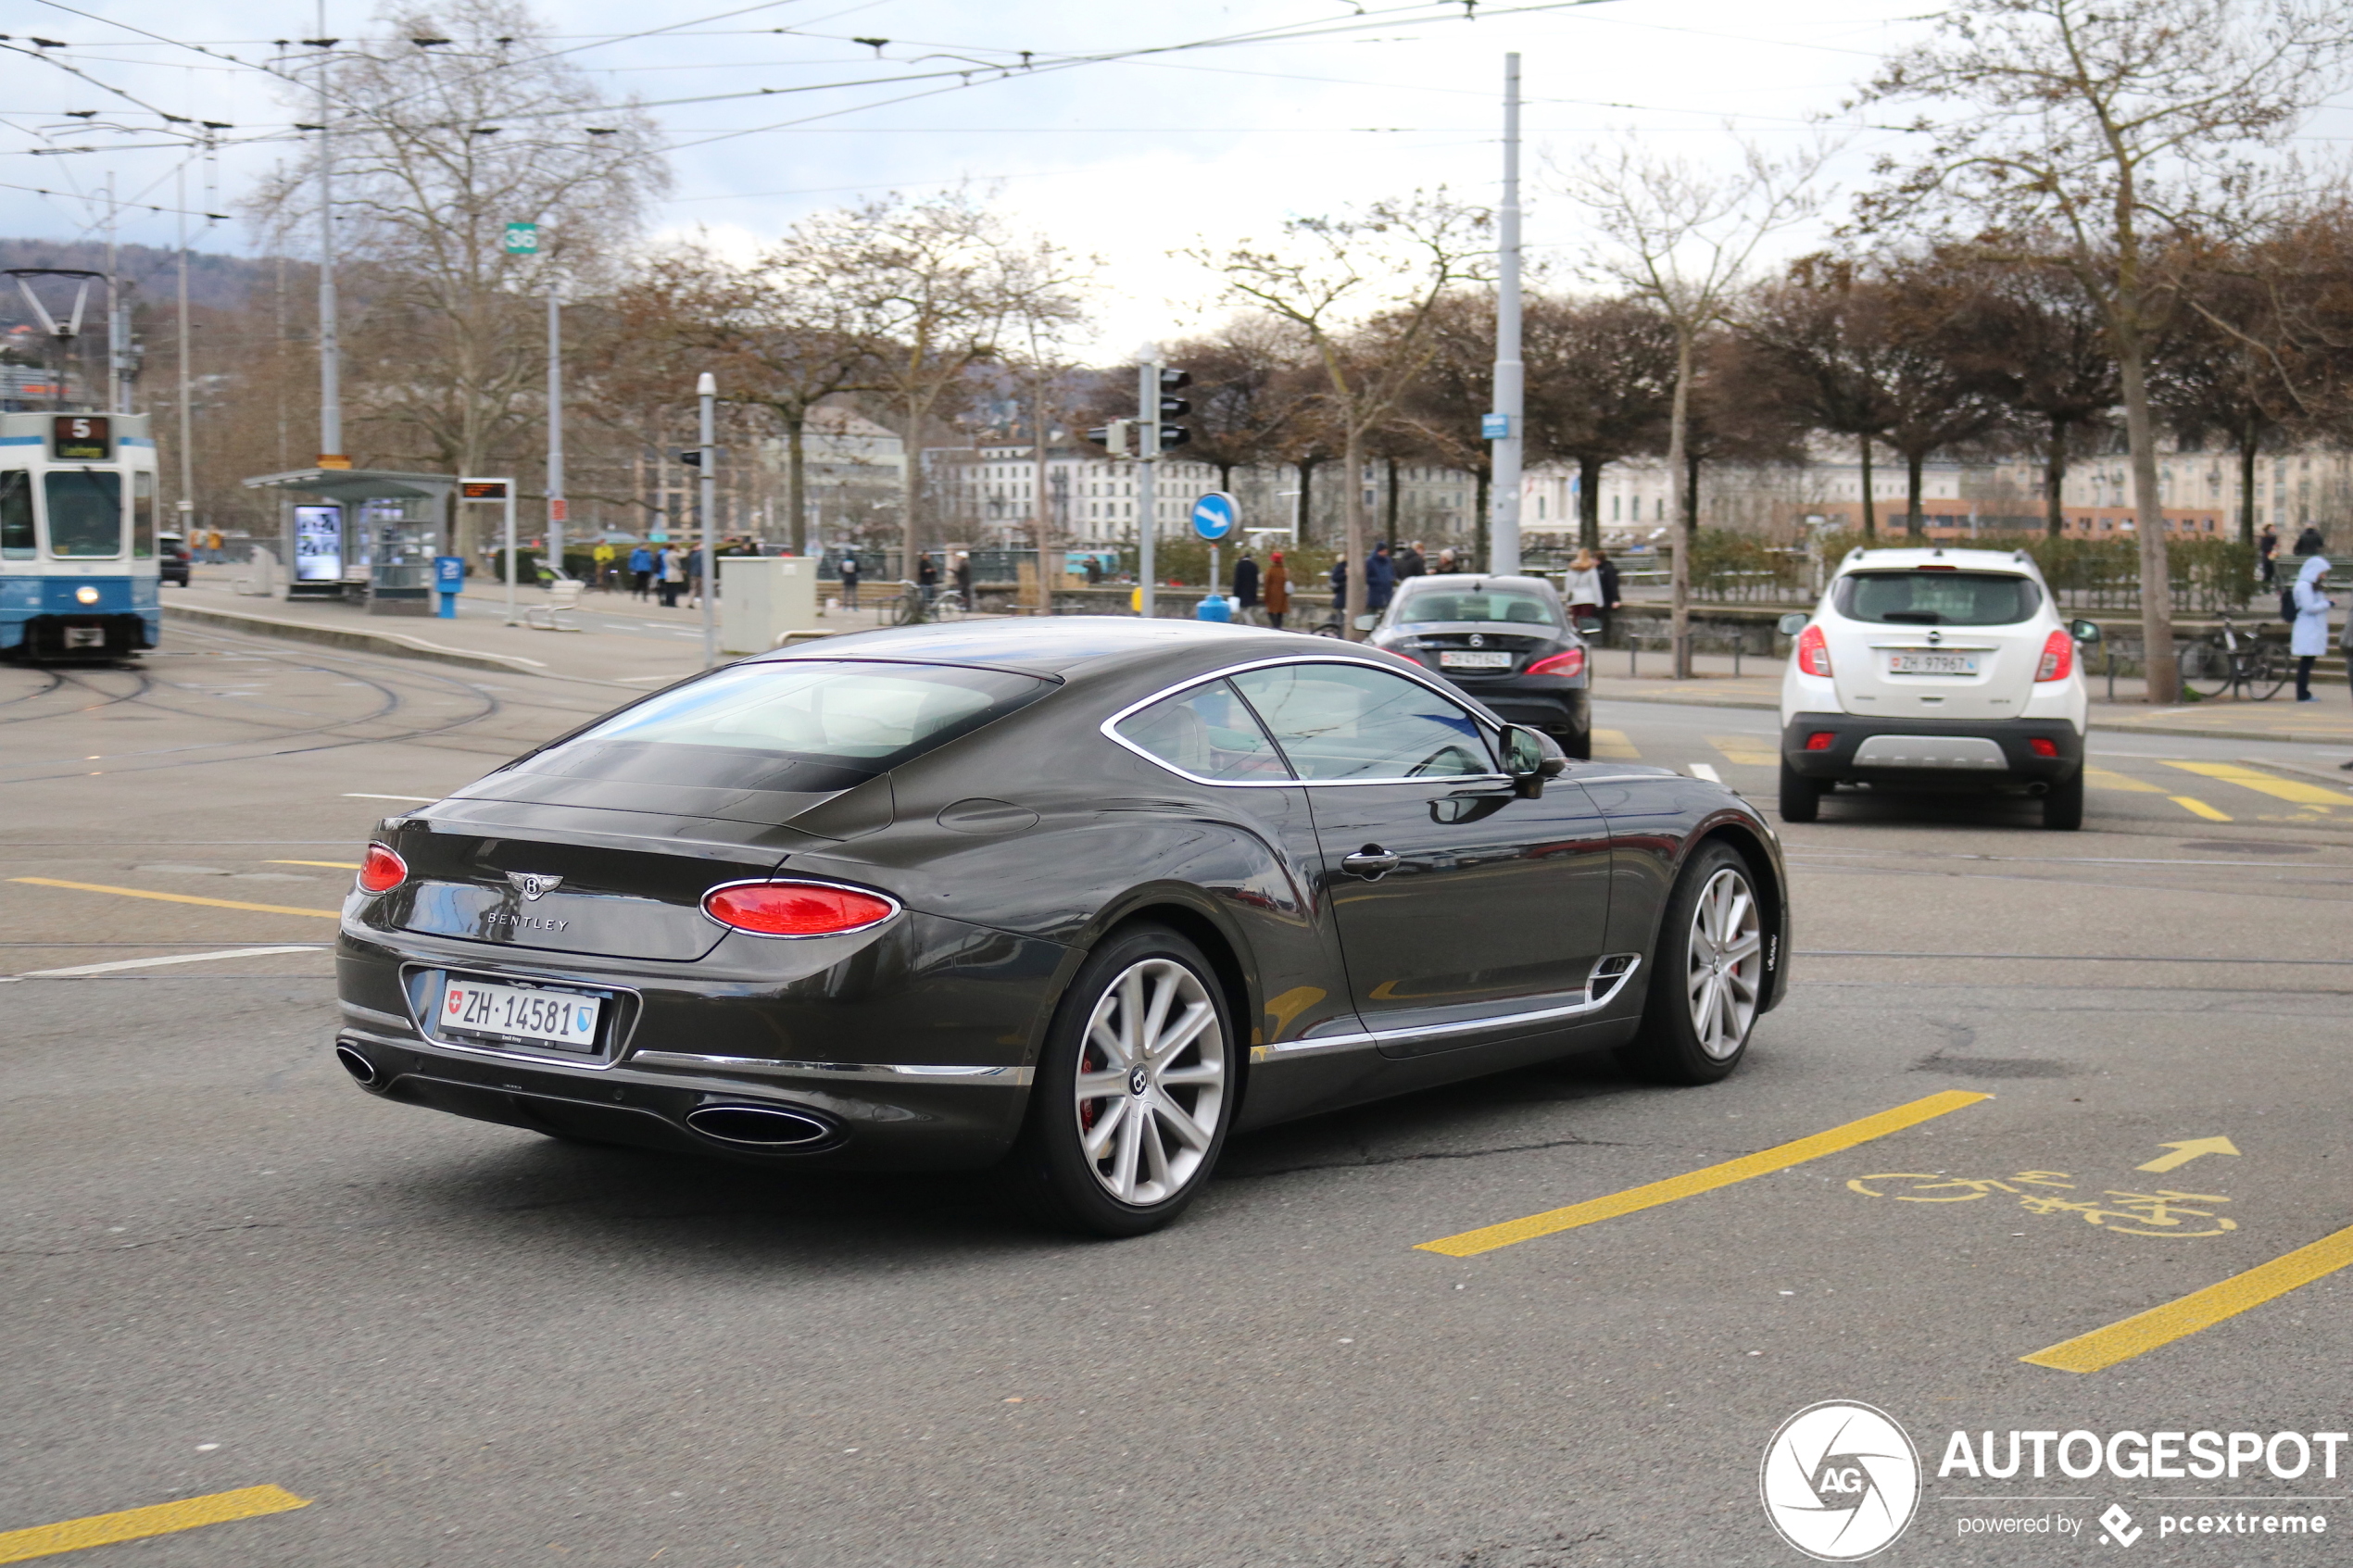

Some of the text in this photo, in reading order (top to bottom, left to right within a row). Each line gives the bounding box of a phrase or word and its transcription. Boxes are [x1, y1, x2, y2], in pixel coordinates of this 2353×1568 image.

[506, 229, 537, 247] 36
[72, 419, 92, 438] 5
[1902, 656, 1966, 671] ZH 97967
[487, 912, 569, 932] BENTLEY
